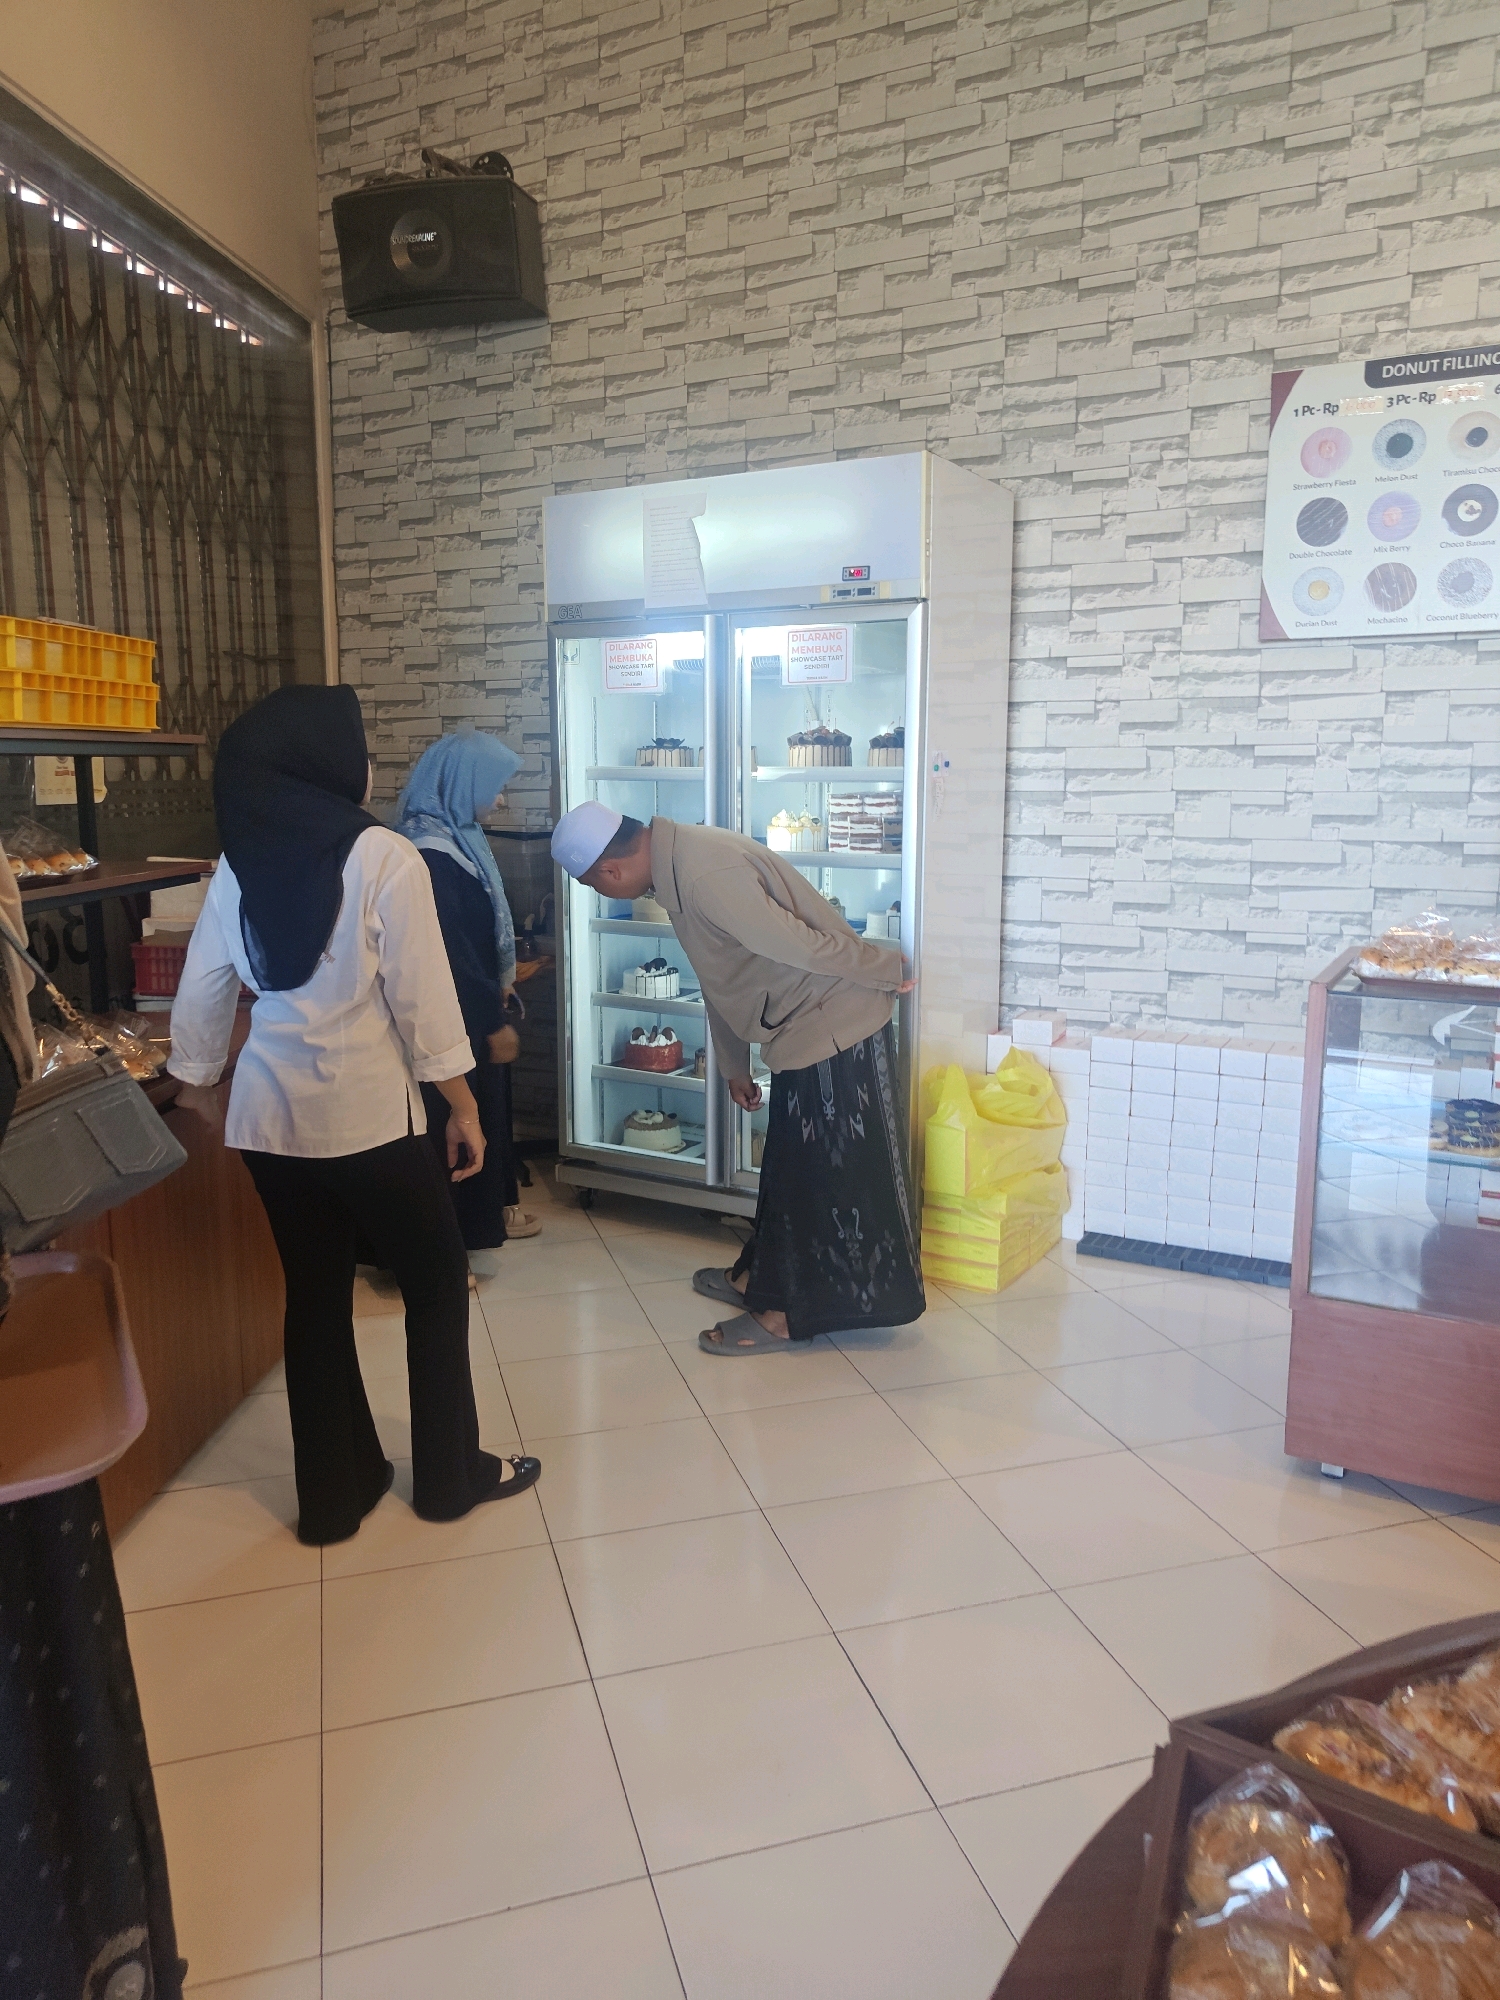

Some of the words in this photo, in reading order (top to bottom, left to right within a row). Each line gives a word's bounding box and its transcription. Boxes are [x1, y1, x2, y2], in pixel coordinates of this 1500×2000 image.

[1382, 359, 1440, 378] DONUT
[1386, 397, 1394, 407] 3
[1293, 408, 1299, 417] 1
[1443, 468, 1477, 477] Tiramisu
[1374, 475, 1399, 483] Melon
[1400, 473, 1418, 481] Dust
[1293, 480, 1333, 491] Strawberry
[1334, 478, 1357, 487] Fiesta
[1439, 541, 1465, 549] Choco
[1466, 539, 1496, 547] Banana
[1289, 550, 1314, 560] Double
[1315, 549, 1353, 558] Chocolate
[1373, 546, 1388, 554] Mix
[1389, 545, 1411, 553] Berry
[558, 604, 583, 619] GEA
[1426, 613, 1459, 622] Coconut
[1459, 611, 1499, 620] Blueberry
[1295, 620, 1319, 628] Durian
[1320, 619, 1338, 627] Dust
[791, 631, 843, 643] DILARANG
[609, 641, 653, 652] DILARANG
[791, 644, 843, 655] MEMBUKA
[609, 653, 653, 663] MEMBUKA
[790, 655, 827, 663] SHOWCASE
